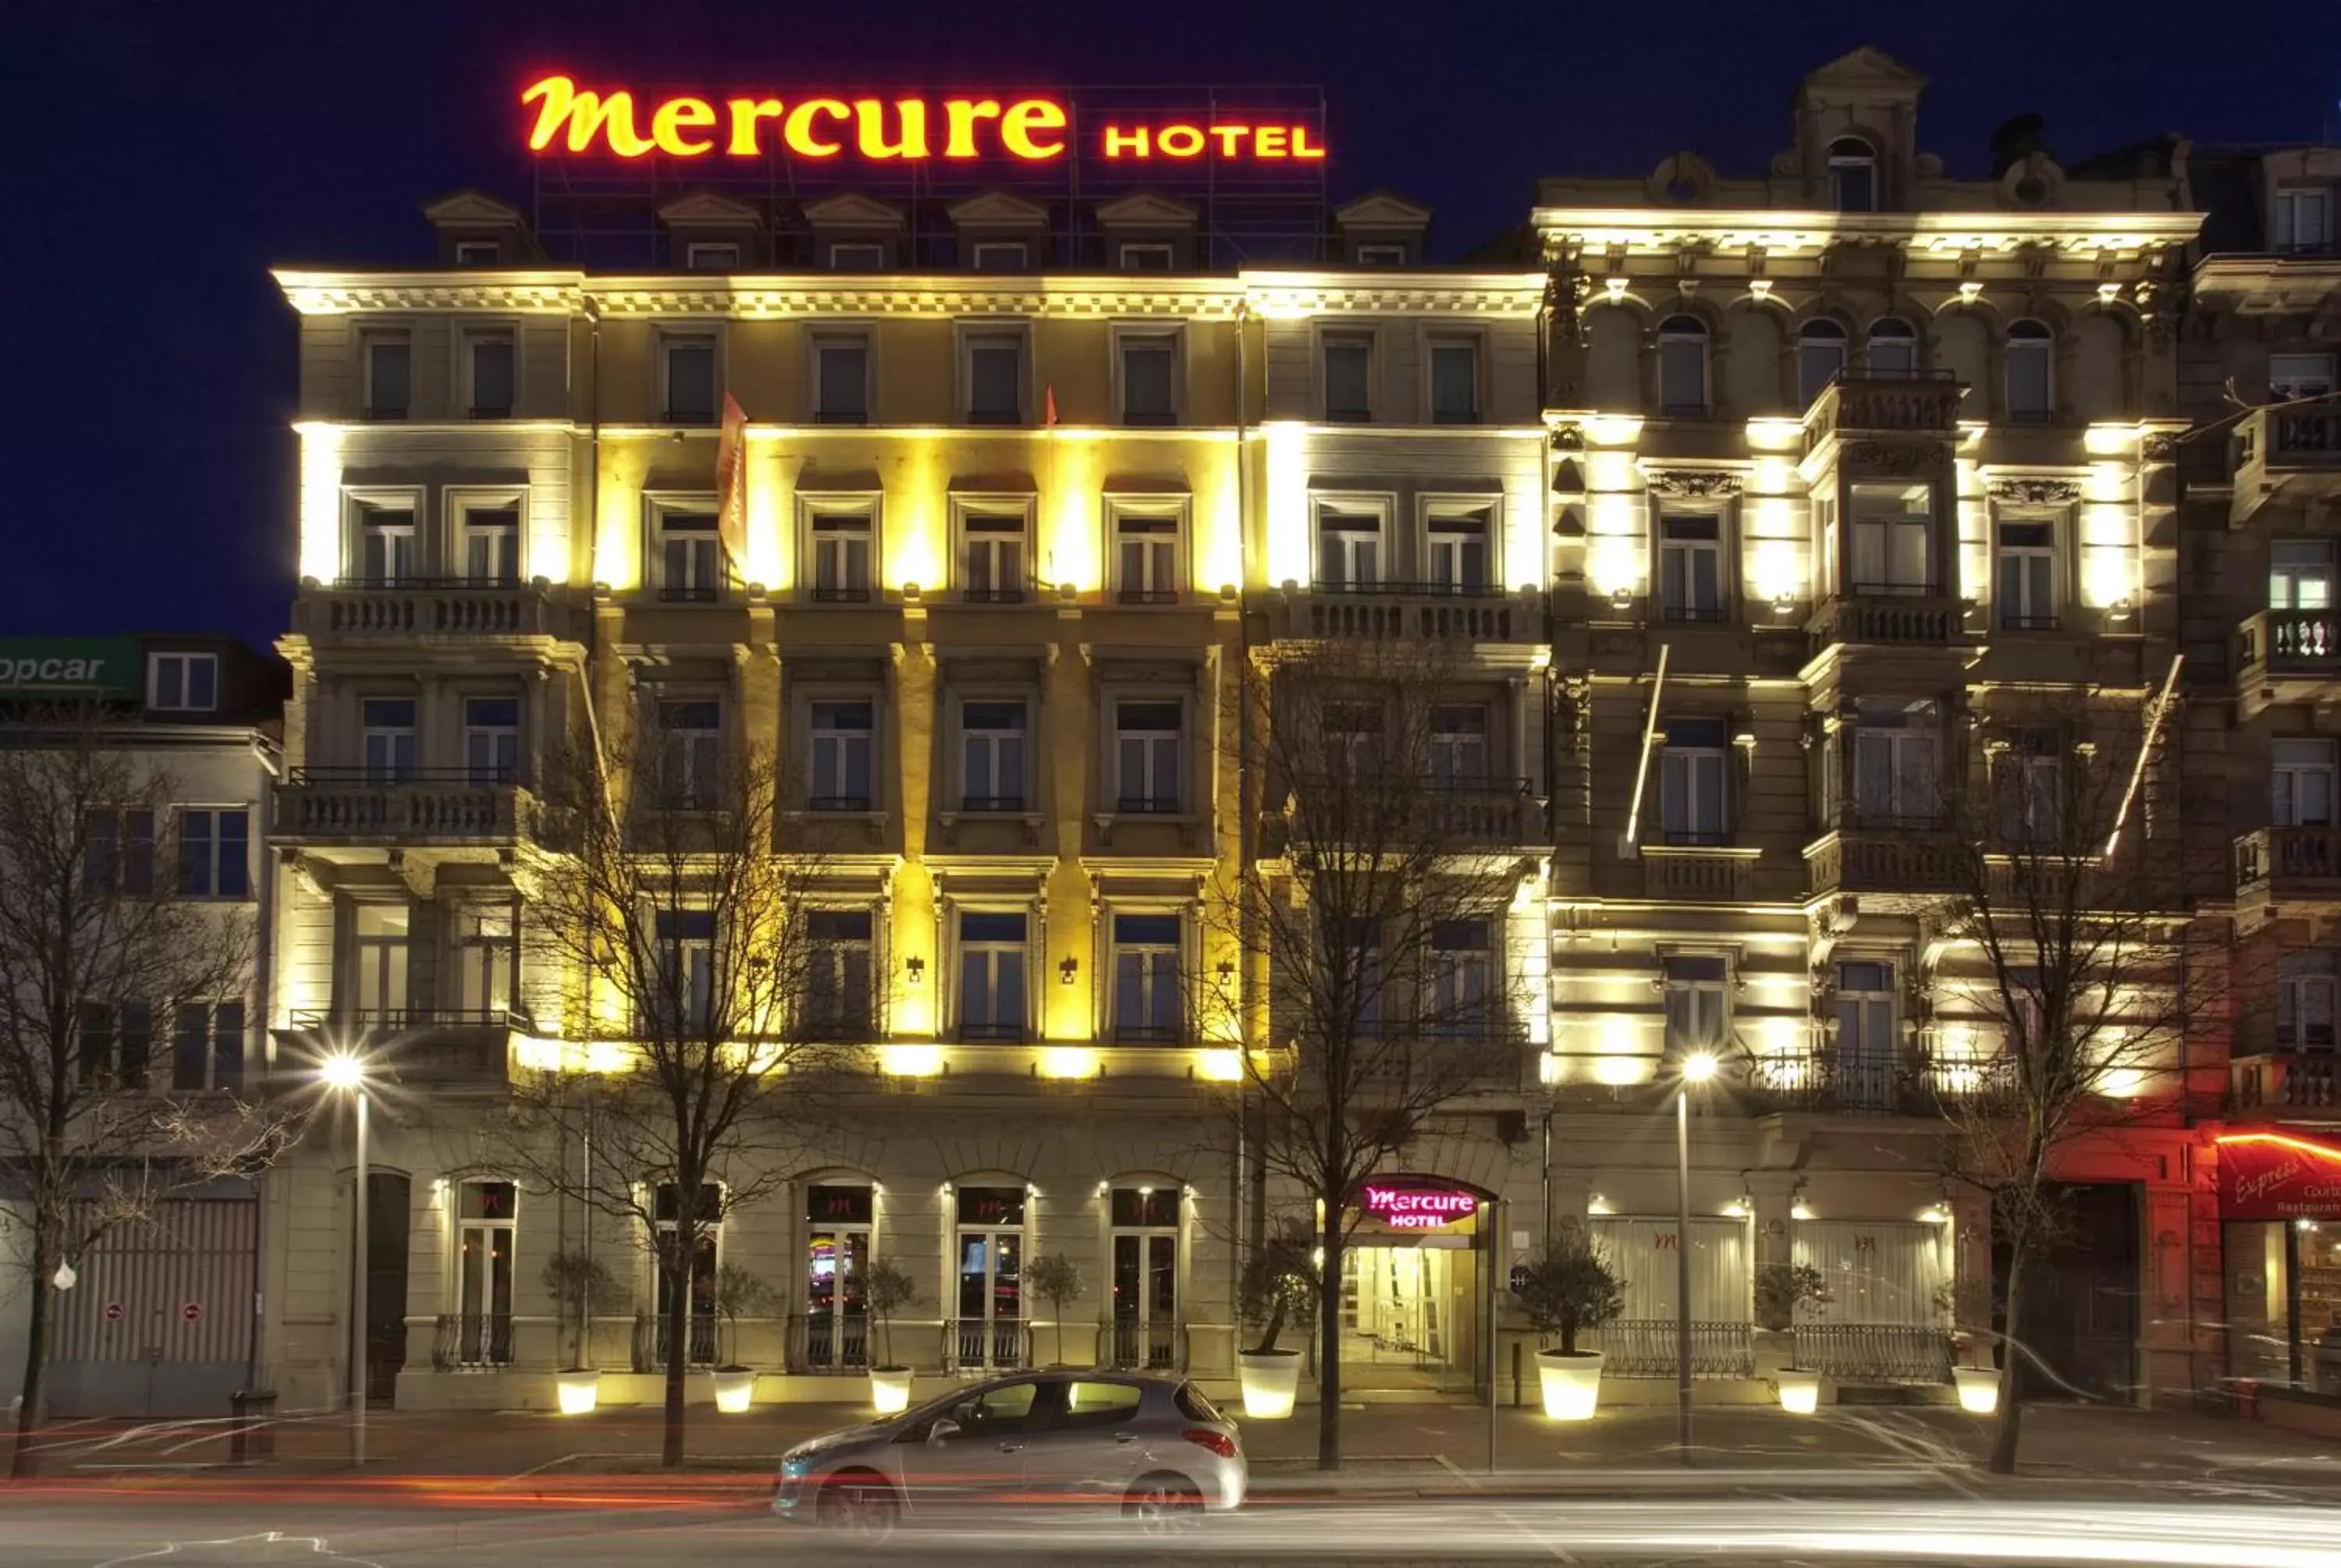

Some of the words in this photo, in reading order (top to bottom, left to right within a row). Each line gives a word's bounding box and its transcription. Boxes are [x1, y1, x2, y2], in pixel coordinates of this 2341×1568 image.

[522, 76, 1066, 159] Mercure
[1105, 125, 1325, 158] HOTEL
[2236, 1158, 2300, 1204] Express
[1366, 1187, 1474, 1211] Mercure
[1391, 1215, 1444, 1227] HOTEL
